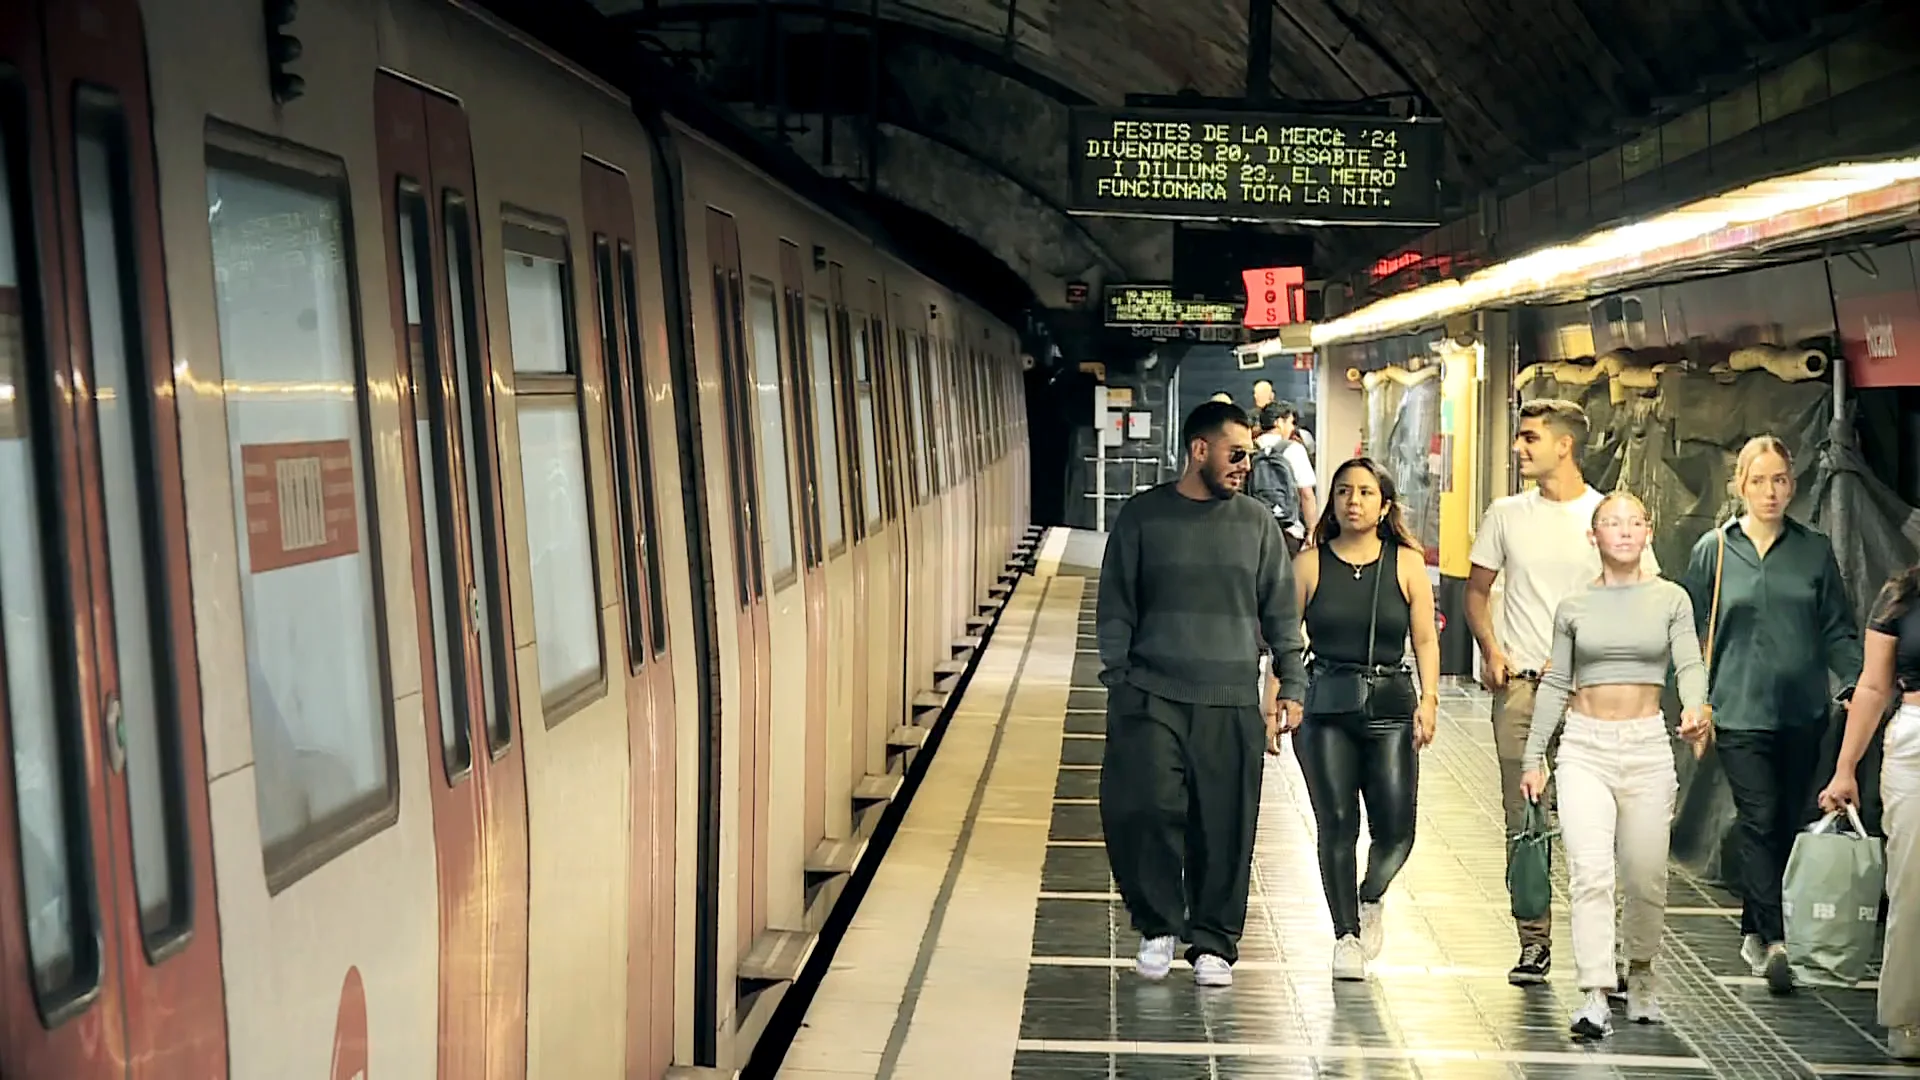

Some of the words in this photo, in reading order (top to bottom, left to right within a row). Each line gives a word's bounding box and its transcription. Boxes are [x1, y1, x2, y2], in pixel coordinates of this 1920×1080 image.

[1113, 121, 1191, 141] FESTES
[1203, 124, 1229, 143] DE
[1242, 125, 1268, 144] LA
[1361, 129, 1398, 148] '24
[1086, 140, 1203, 161] DIVENDRES
[1215, 144, 1250, 162] 20,
[1267, 146, 1371, 167] DISSABTE
[1383, 150, 1408, 169] 21
[1113, 160, 1123, 177] I
[1137, 160, 1228, 181] DILLUNS
[1240, 164, 1275, 183] 23,
[1292, 166, 1318, 184] EL
[1331, 167, 1397, 187] METRO
[1098, 179, 1227, 201] FUNCIONARA
[1240, 183, 1292, 203] TOTA
[1304, 186, 1330, 204] LA
[1343, 187, 1391, 206] NIT.
[1264, 271, 1277, 323] SOS
[1131, 325, 1180, 338] Sortida
